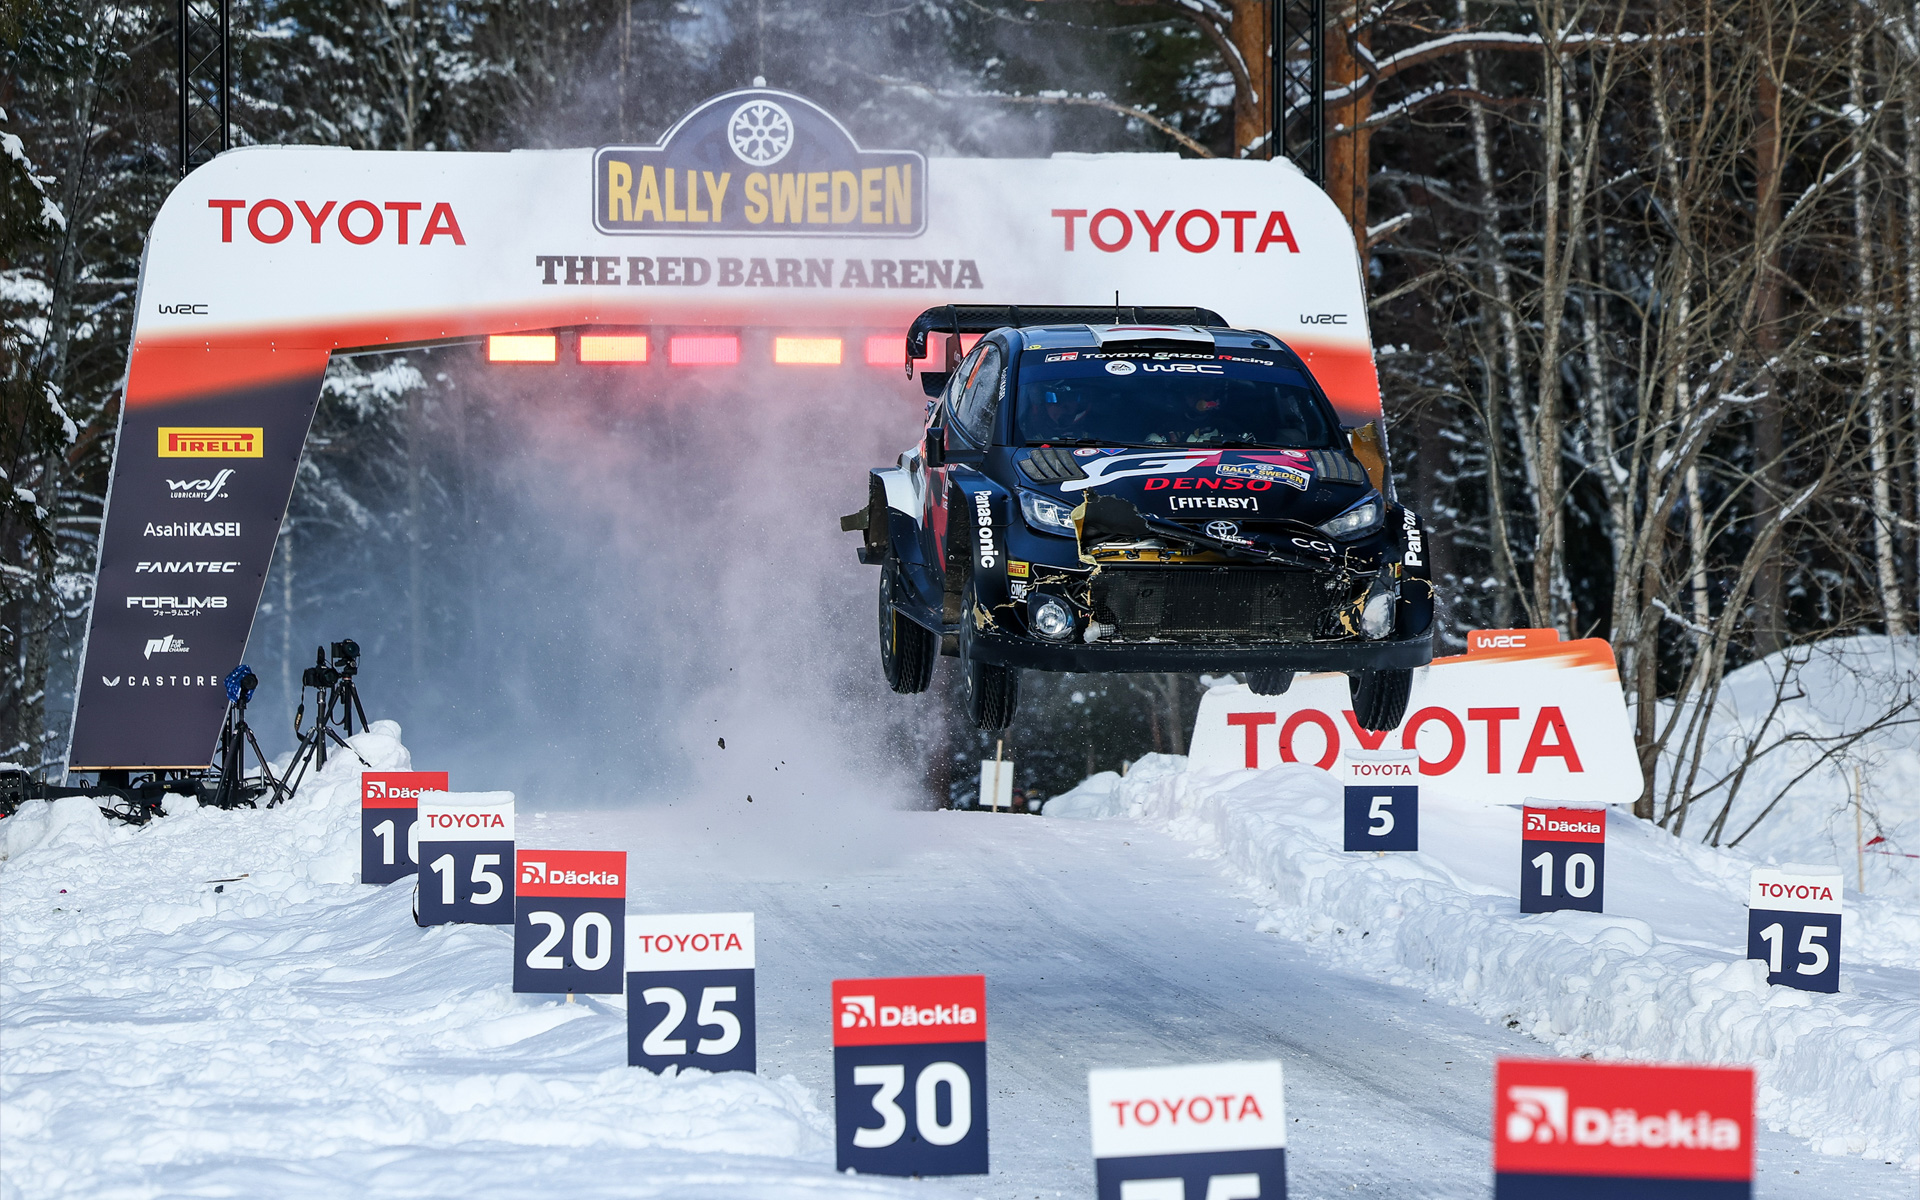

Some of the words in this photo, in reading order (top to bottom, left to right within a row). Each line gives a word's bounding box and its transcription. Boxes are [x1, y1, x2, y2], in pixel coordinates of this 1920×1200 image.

[608, 160, 730, 223] RALLY
[744, 164, 912, 225] SWEDEN
[208, 199, 467, 246] TOYOTA
[1051, 208, 1301, 254] TOYOTA
[536, 255, 621, 286] THE
[627, 256, 712, 287] RED
[717, 257, 834, 289] BARN
[839, 259, 984, 290] ARENA
[158, 303, 209, 316] WRC
[1300, 314, 1348, 325] WRC
[1142, 363, 1225, 375] WRC
[1218, 355, 1274, 366] Racing
[168, 433, 255, 452] PIRELLI
[1144, 477, 1273, 492] DENSO
[1222, 465, 1256, 474] RALLY
[1258, 469, 1304, 484] SWEDEN
[973, 490, 999, 569] Panasonic
[135, 561, 238, 573] FANATEC
[126, 596, 228, 608] FORUM8
[1477, 635, 1527, 649] WRC
[128, 675, 218, 687] CASTORE
[1352, 764, 1412, 776] TOYOTA
[426, 814, 505, 828] TOYOTA
[1367, 796, 1396, 837] 5
[1548, 820, 1601, 834] Däckia
[429, 853, 504, 905] 15
[550, 870, 620, 886] Däckia
[1531, 851, 1596, 898] 10
[1758, 882, 1834, 901] TOYOTA
[526, 911, 613, 971] 20
[639, 933, 743, 954] TOYOTA
[1759, 922, 1830, 976] 15
[641, 985, 742, 1056] 25
[879, 1004, 978, 1028] Däckia
[852, 1061, 972, 1149] 30
[1110, 1093, 1264, 1129] TOYOTA
[1571, 1107, 1743, 1152] Däckia
